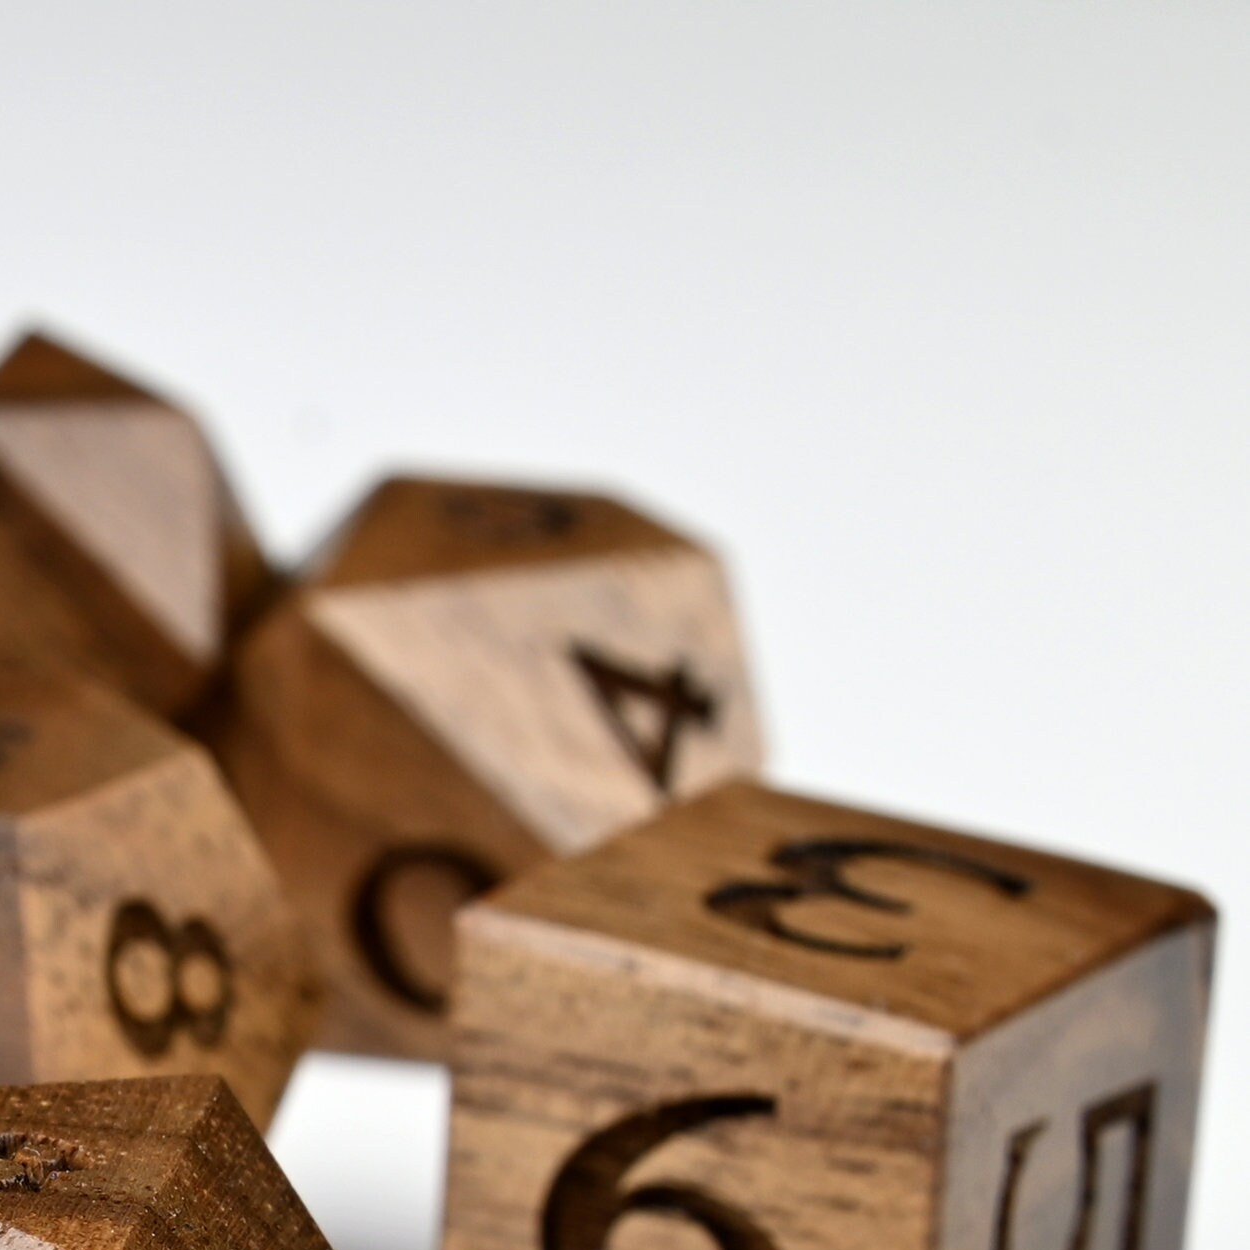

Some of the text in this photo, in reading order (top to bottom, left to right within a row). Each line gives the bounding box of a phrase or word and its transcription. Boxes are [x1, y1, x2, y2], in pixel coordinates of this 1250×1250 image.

[567, 637, 721, 794] 4
[104, 896, 235, 1060] 8
[703, 838, 1034, 961] 3
